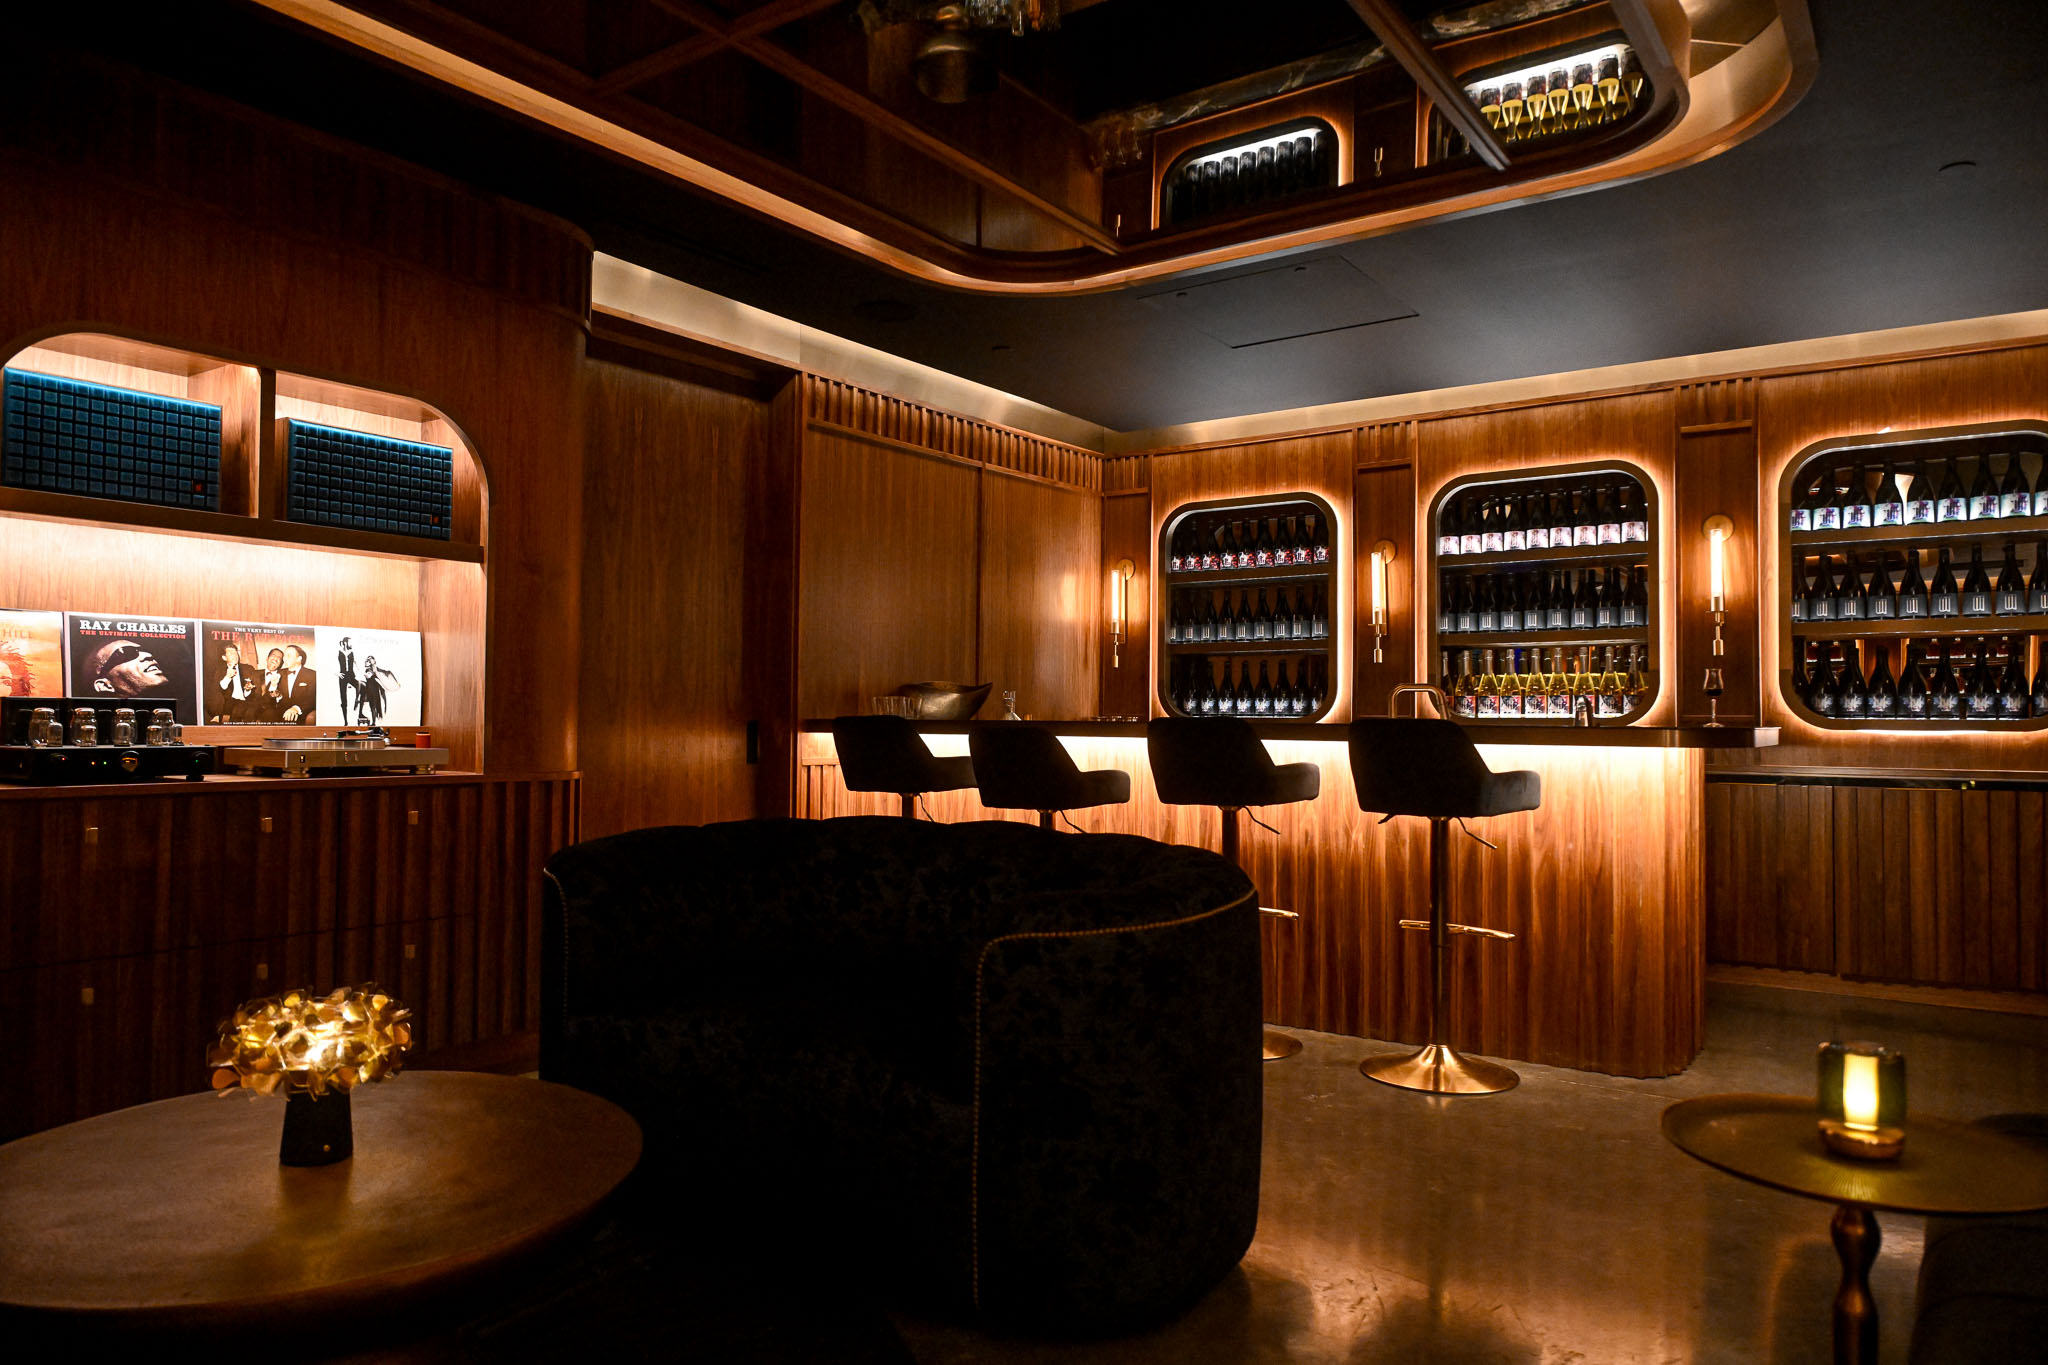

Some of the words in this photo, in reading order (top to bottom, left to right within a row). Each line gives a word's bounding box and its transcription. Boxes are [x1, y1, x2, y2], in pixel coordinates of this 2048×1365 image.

[80, 620, 112, 630] RAY
[117, 621, 187, 634] CHARLES
[99, 630, 138, 638] ULTIMATE
[140, 632, 187, 640] COLLECTION
[211, 630, 240, 641] THE
[245, 632, 271, 642] RAT
